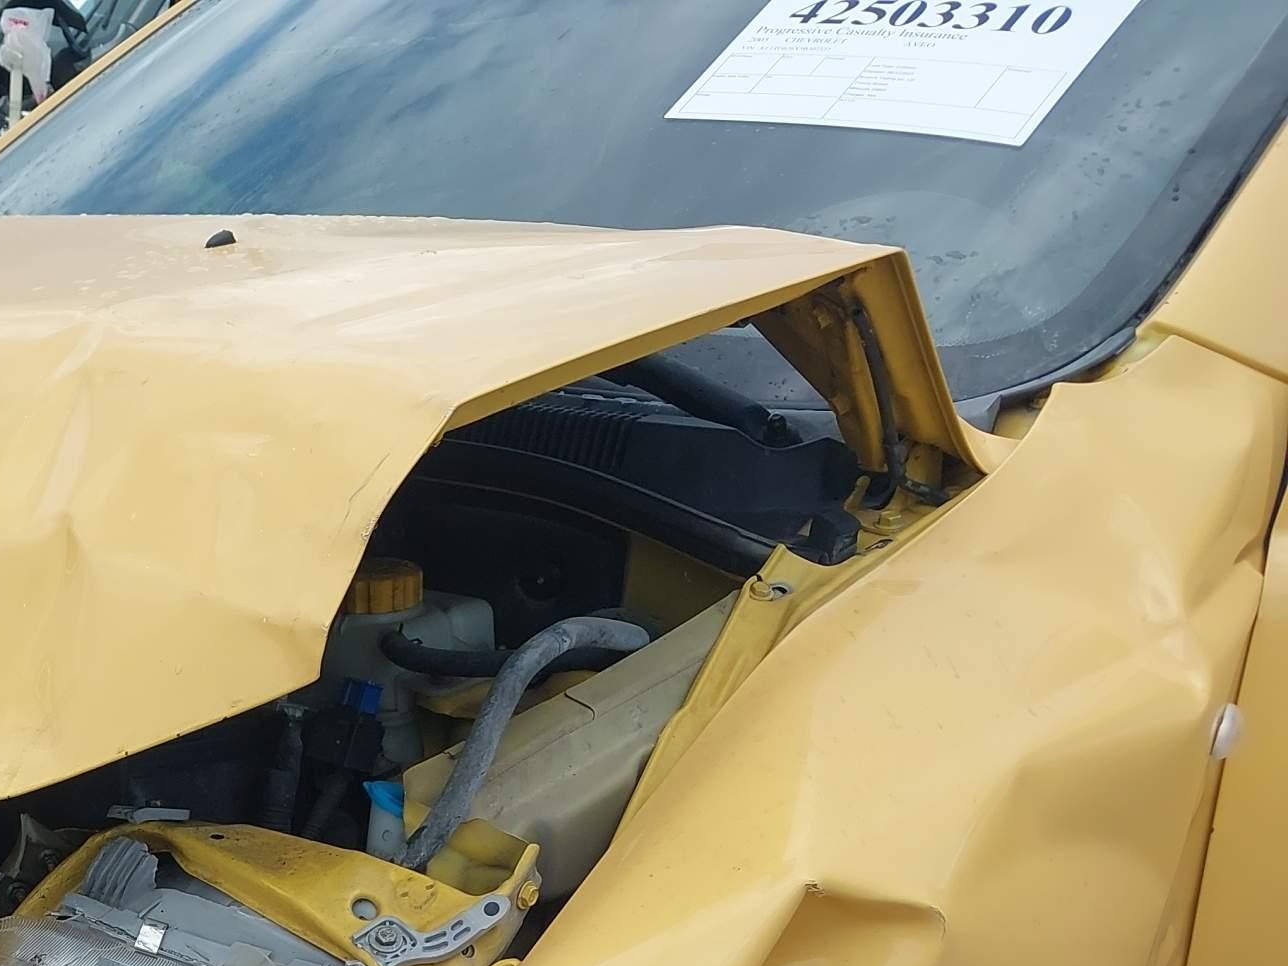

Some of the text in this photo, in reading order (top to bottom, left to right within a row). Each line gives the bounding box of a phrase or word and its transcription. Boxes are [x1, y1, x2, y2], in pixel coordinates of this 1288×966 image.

[788, 0, 1073, 36] 42503310
[756, 25, 969, 41] Progressive Casualty Insurance
